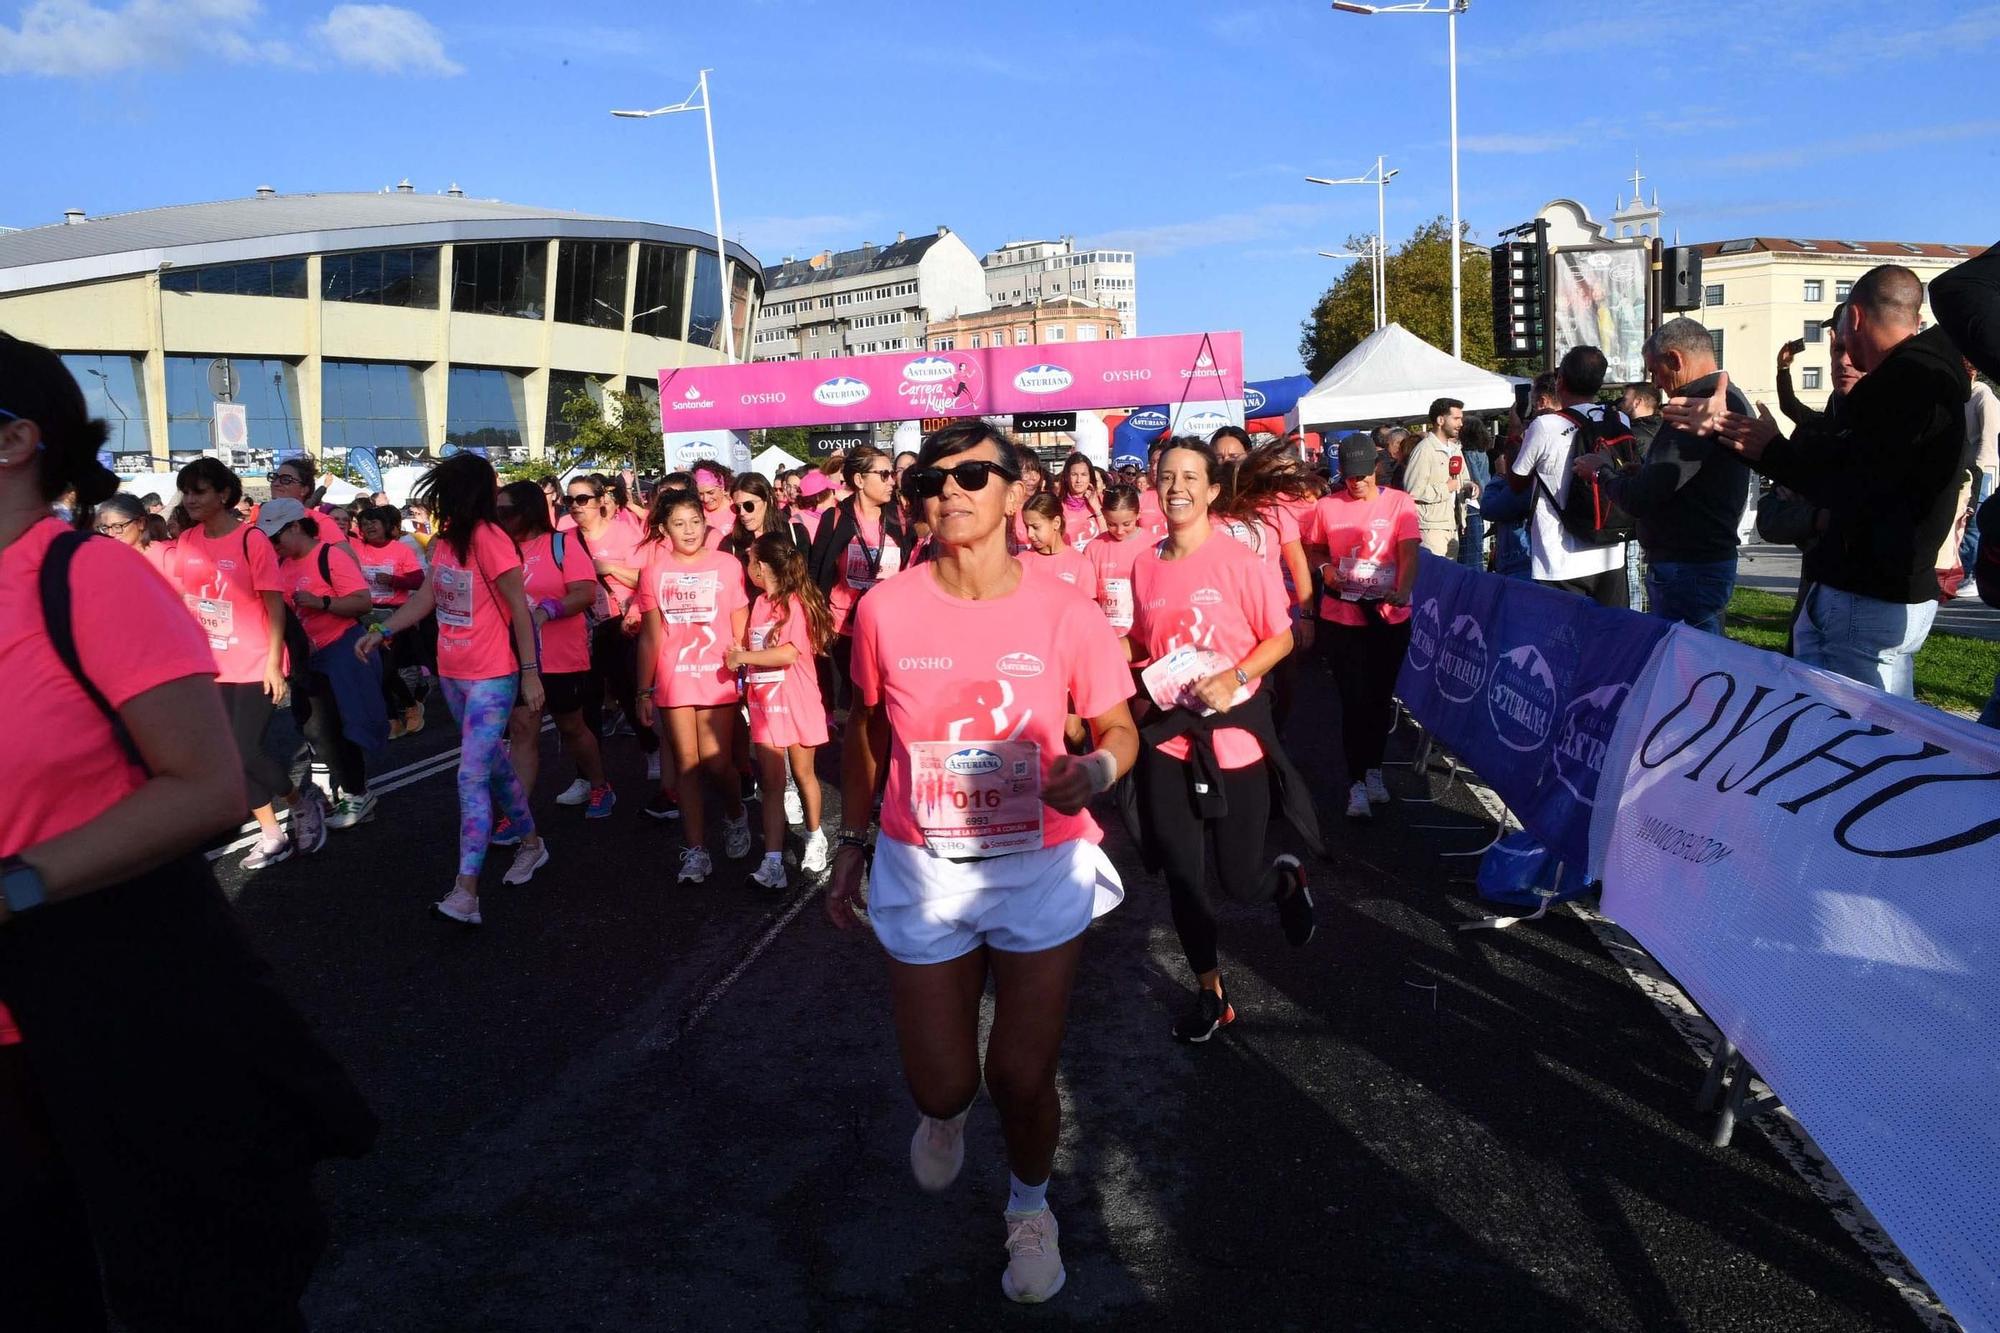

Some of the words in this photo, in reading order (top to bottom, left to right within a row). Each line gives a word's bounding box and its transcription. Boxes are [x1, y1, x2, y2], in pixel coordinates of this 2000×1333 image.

[906, 365, 953, 376] ASTURIANA
[1103, 369, 1151, 382] OYSHO
[1181, 367, 1228, 379] Santander
[1018, 376, 1069, 387] ASTURIANA
[817, 388, 866, 401] ASTURIANA
[898, 381, 943, 397] Carrera
[741, 392, 786, 405] OYSHO
[925, 392, 960, 415] Mujer
[672, 400, 715, 410] Santander
[1022, 418, 1068, 429] OYSHO
[818, 438, 862, 450] OYSHO
[676, 591, 697, 601] 016
[200, 617, 218, 628] 016
[898, 656, 953, 671] OYSHO
[949, 760, 999, 770] ASTURIANA
[952, 788, 1001, 809] 016
[965, 816, 989, 826] 6993
